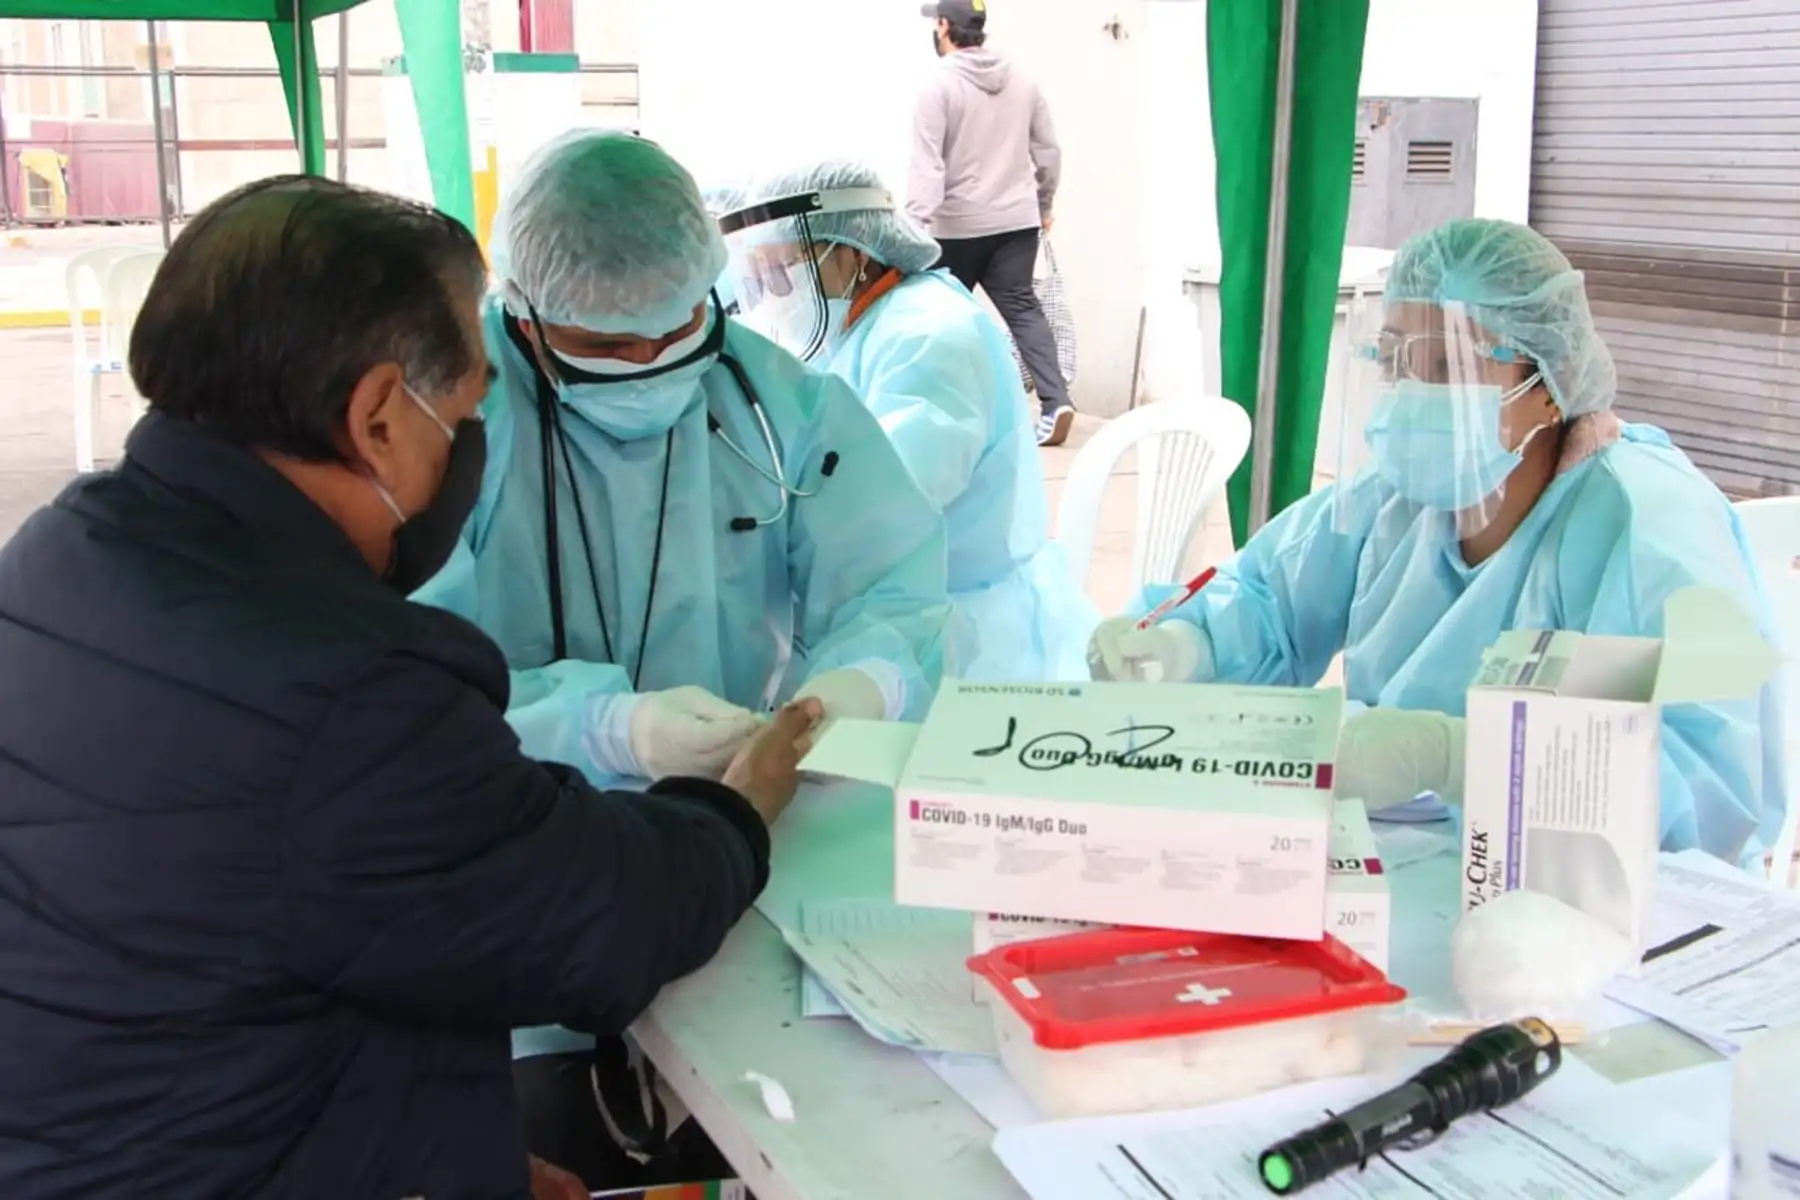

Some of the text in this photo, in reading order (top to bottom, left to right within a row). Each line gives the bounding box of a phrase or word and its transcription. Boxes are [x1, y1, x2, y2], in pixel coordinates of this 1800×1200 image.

[1192, 758, 1313, 780] COVID-19
[922, 807, 1088, 835] COVID-19 IgM/IgG Duo
[1270, 834, 1292, 853] 20
[1466, 827, 1489, 912] U-CHEK
[1337, 911, 1358, 926] 20
